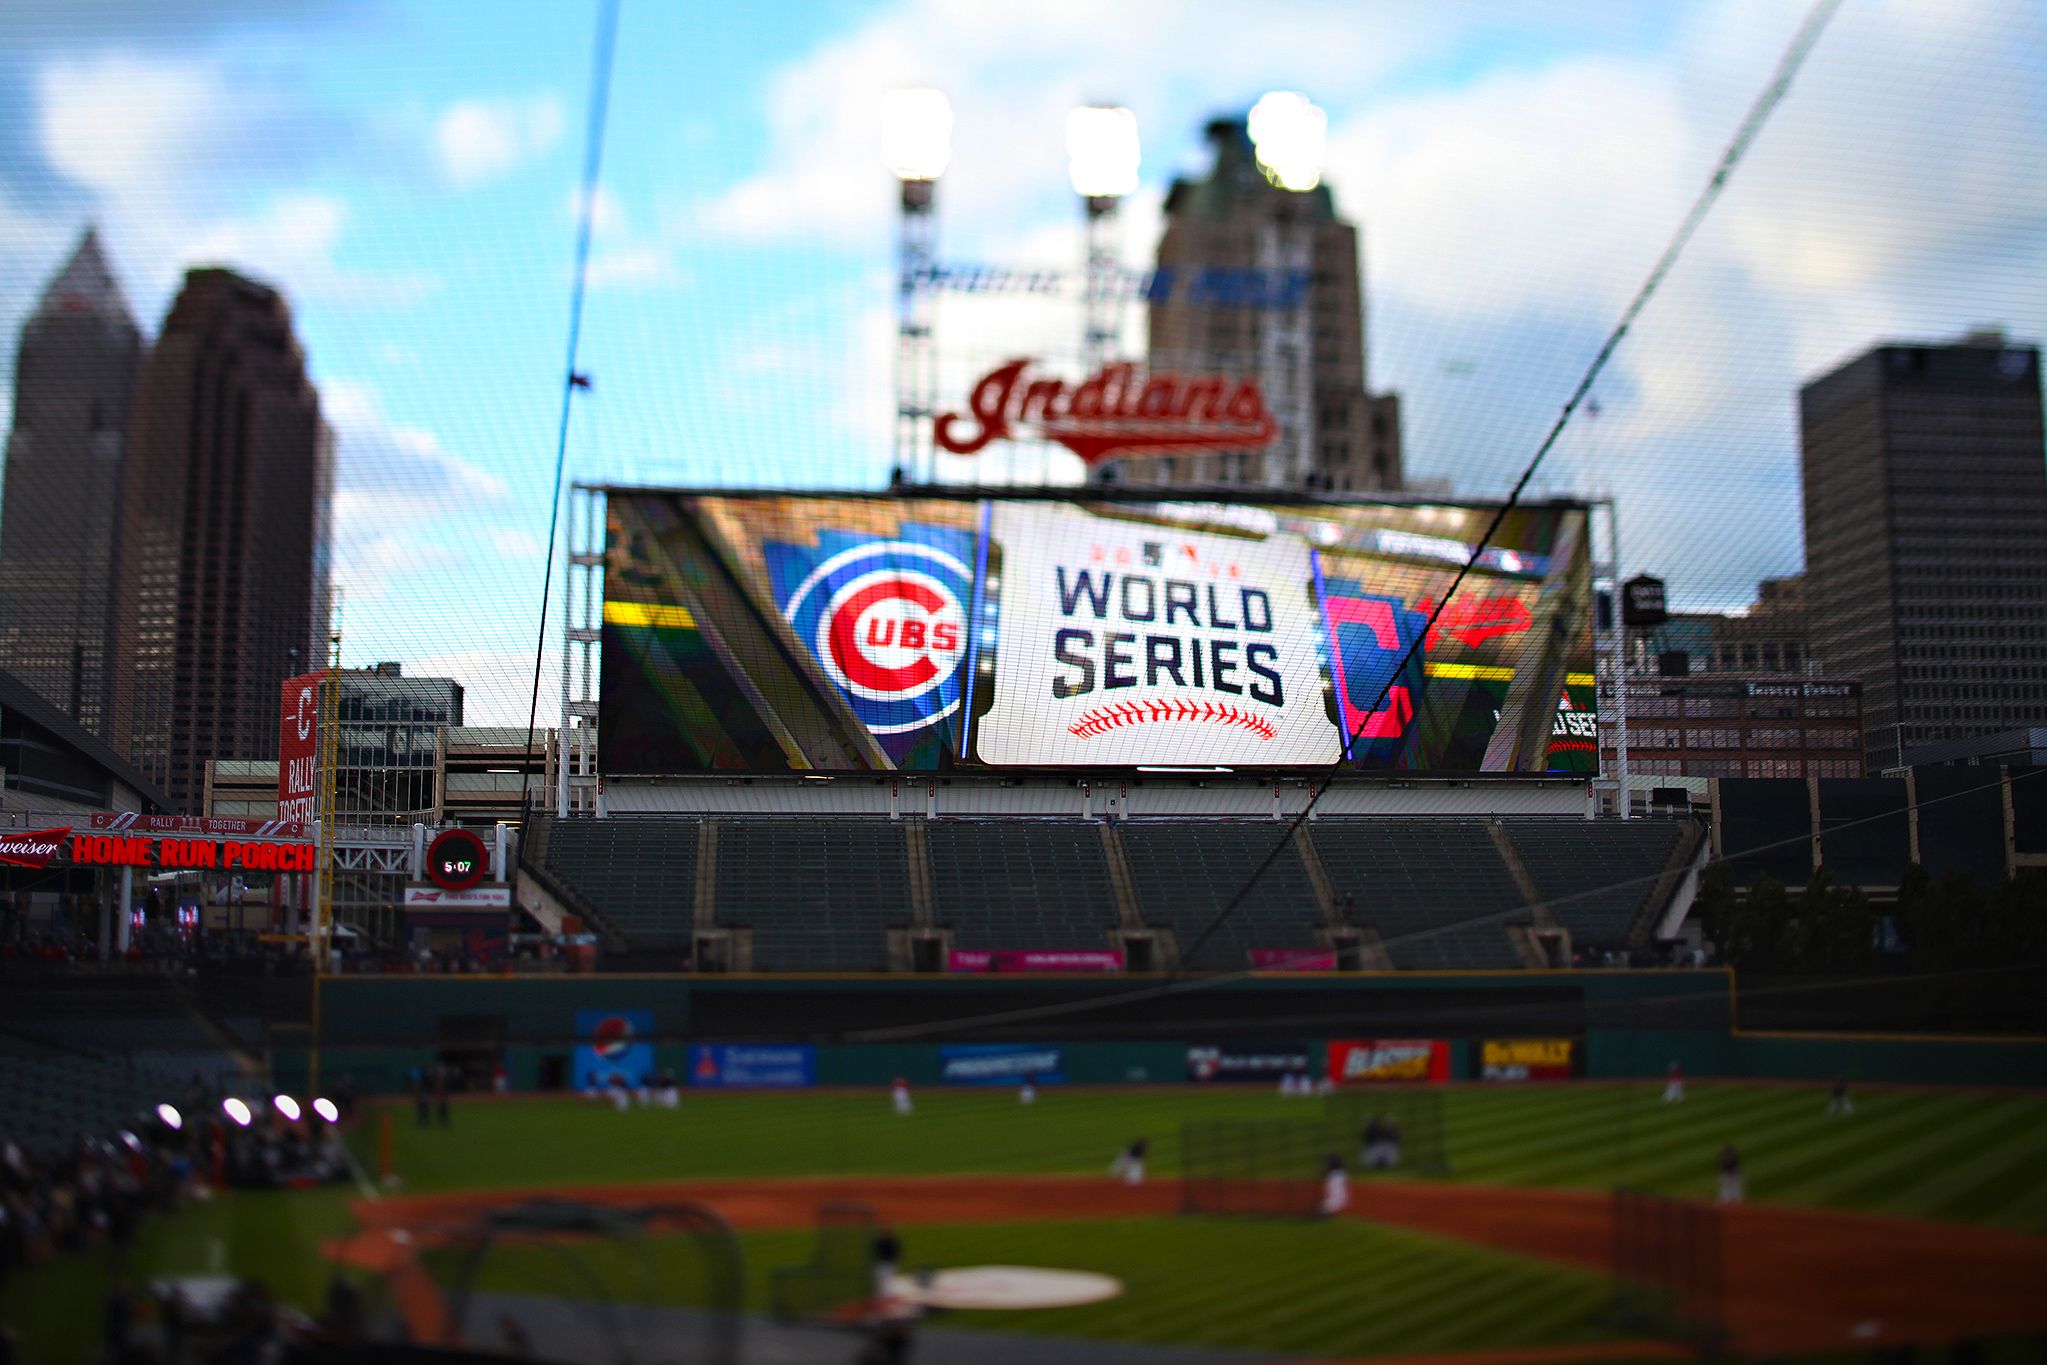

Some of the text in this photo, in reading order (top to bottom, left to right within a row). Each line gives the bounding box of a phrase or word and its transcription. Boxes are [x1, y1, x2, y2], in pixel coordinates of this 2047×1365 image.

[934, 358, 1277, 463] Indians
[1056, 565, 1272, 633] WORLD
[1053, 627, 1284, 708] SERIES
[288, 754, 316, 794] RALLY
[150, 817, 174, 828] RALLY
[208, 819, 247, 831] TOGETHER
[0, 838, 58, 855] weiser
[72, 834, 314, 872] HOME RUN PORCH
[444, 861, 472, 874] 5:07
